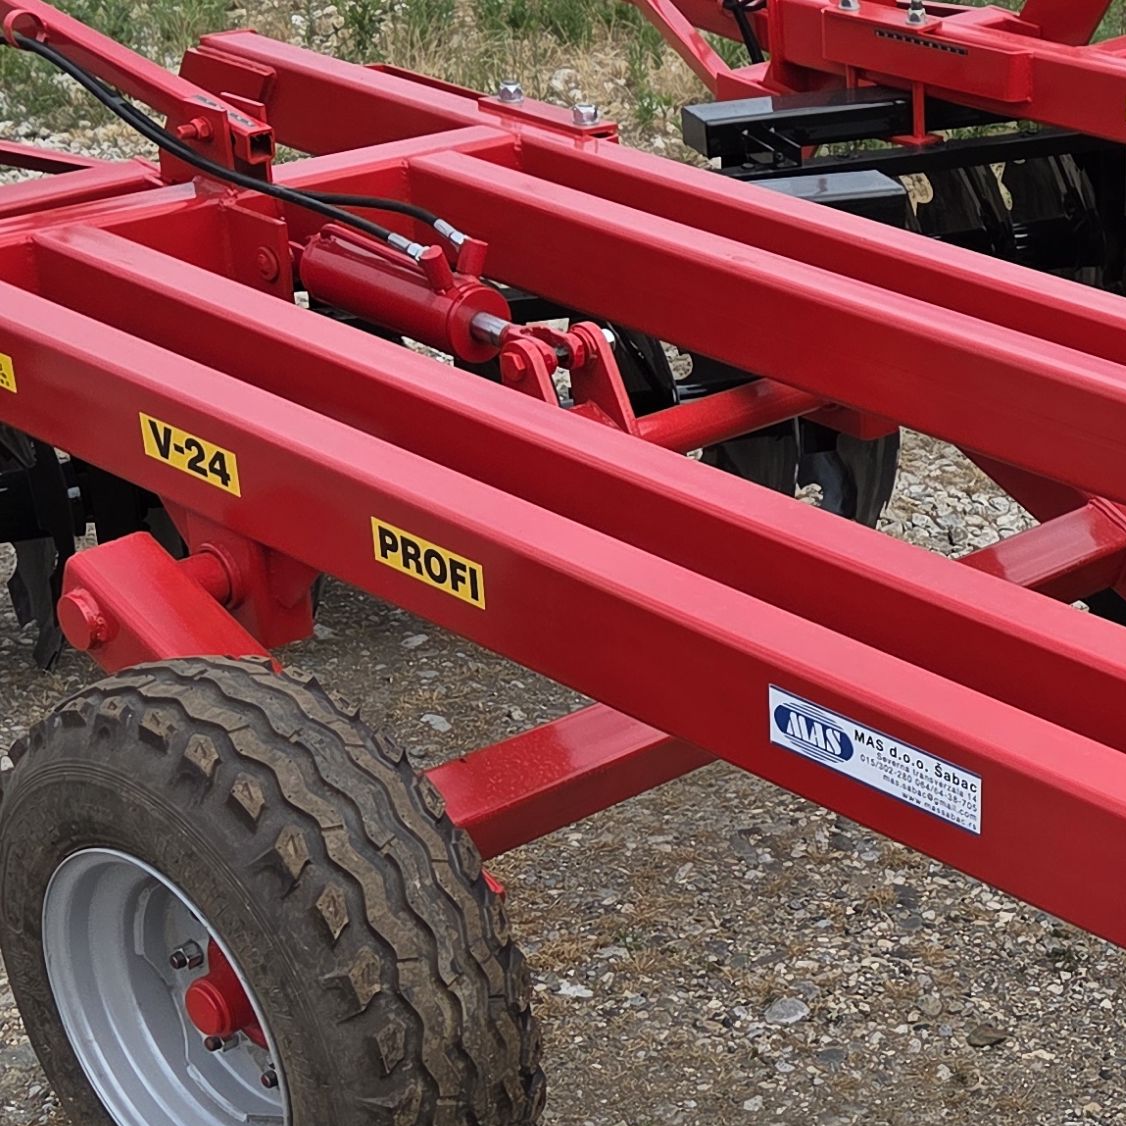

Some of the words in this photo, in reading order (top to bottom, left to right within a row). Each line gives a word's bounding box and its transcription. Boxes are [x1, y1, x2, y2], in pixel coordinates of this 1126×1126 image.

[148, 419, 231, 488] V-24
[378, 525, 479, 602] PROFI
[786, 711, 842, 755] MAS
[854, 729, 884, 751] MAS
[889, 746, 929, 773] d.o.o.
[934, 762, 977, 793] Šabac
